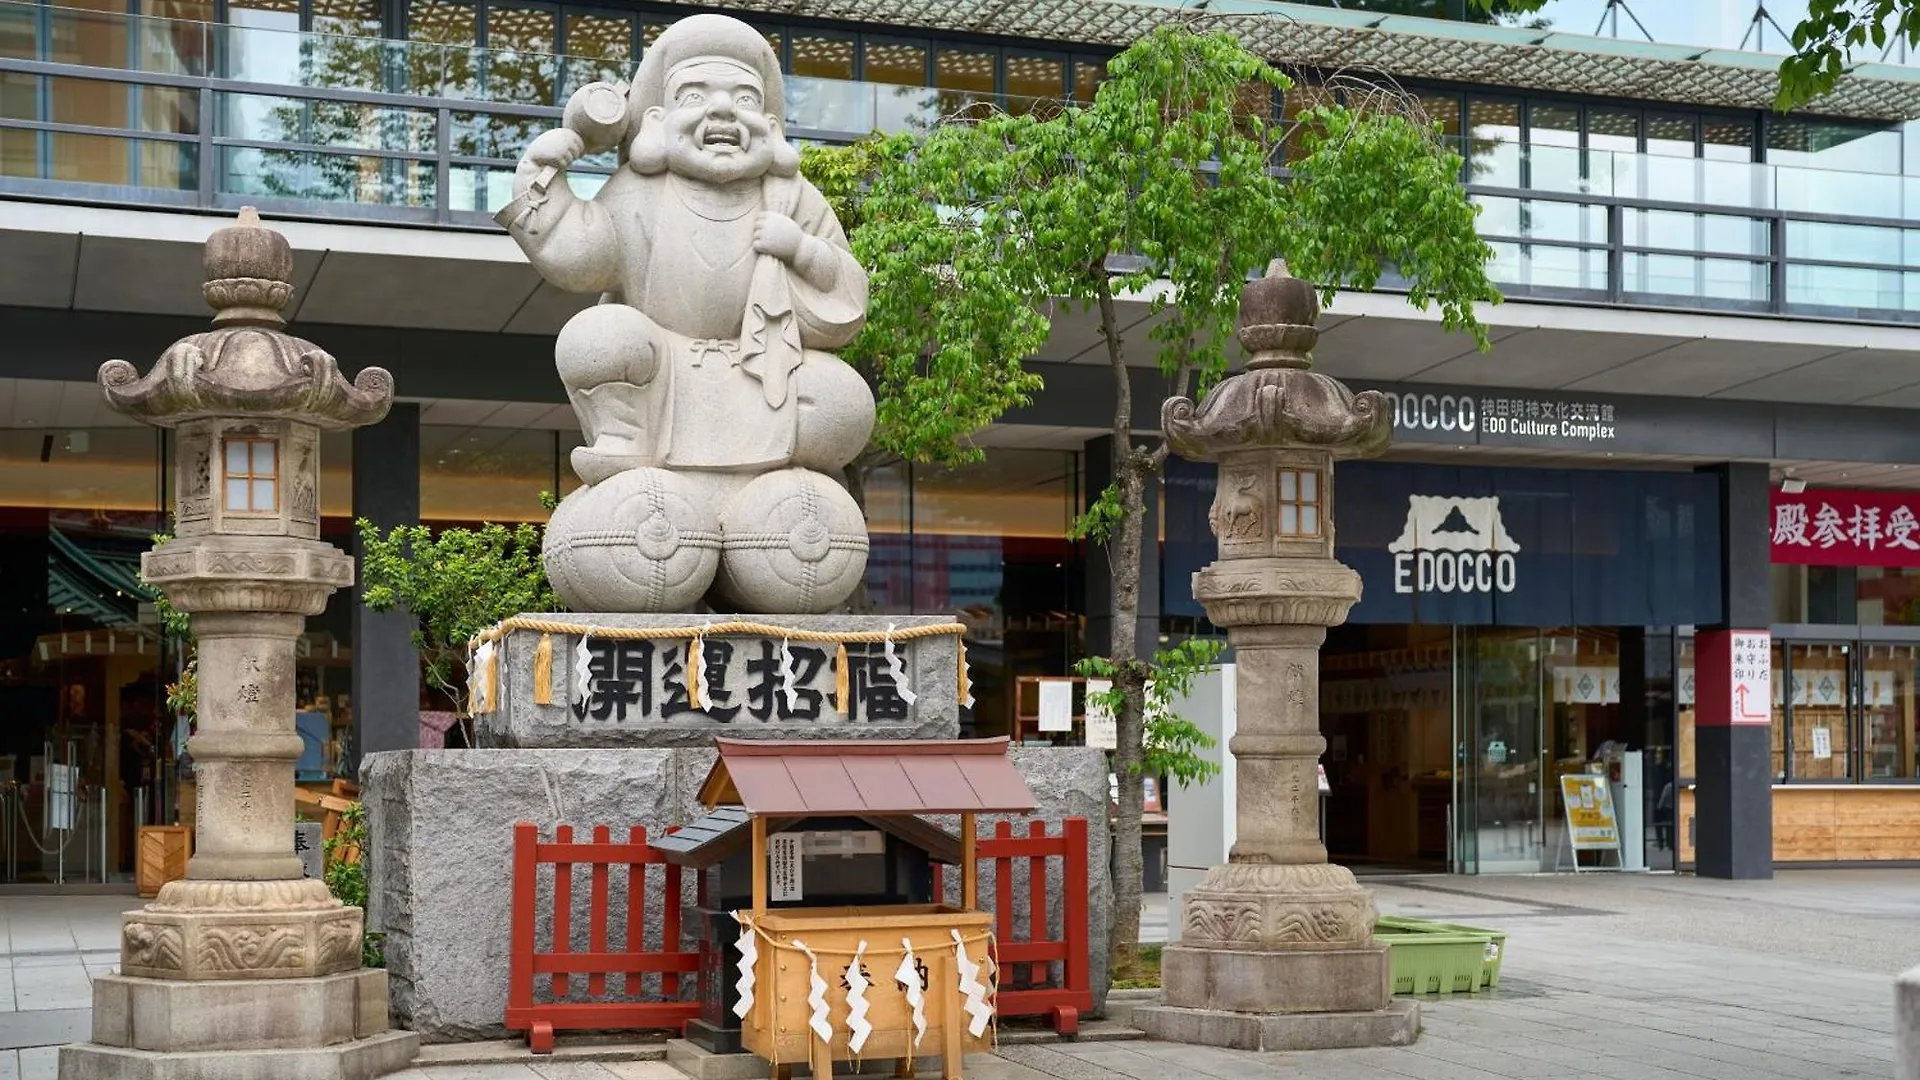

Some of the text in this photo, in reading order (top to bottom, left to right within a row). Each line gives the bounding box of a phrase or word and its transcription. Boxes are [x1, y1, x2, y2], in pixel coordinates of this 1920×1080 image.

[1481, 398, 1614, 421] 神田明神文化交流館
[1482, 417, 1615, 441] EDO Culture Complex
[1395, 552, 1516, 593] EDOCCO
[1746, 638, 1756, 680] お守り
[1758, 638, 1768, 681] おふだ
[571, 638, 908, 723] 開運招福
